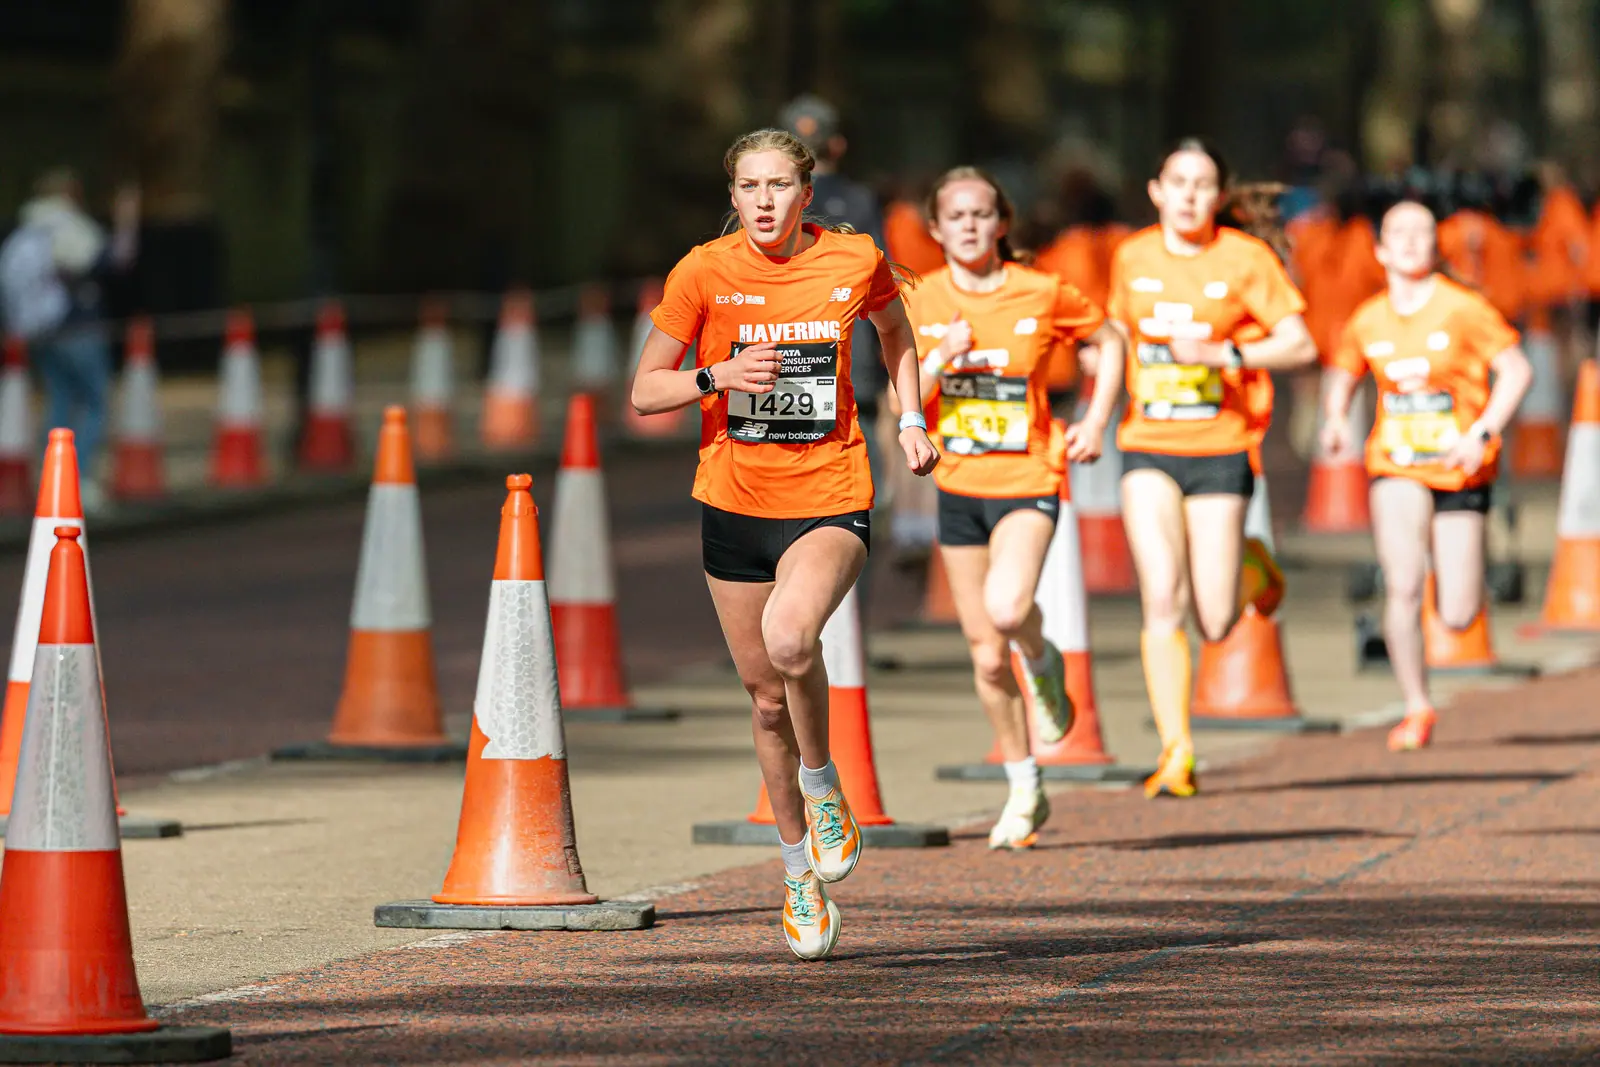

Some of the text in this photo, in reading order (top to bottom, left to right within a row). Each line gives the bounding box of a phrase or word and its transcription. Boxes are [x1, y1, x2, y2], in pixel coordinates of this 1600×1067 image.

[739, 320, 841, 343] HAVERING
[780, 365, 812, 373] ERVICES
[748, 392, 814, 416] 1429
[768, 431, 825, 440] new balance
